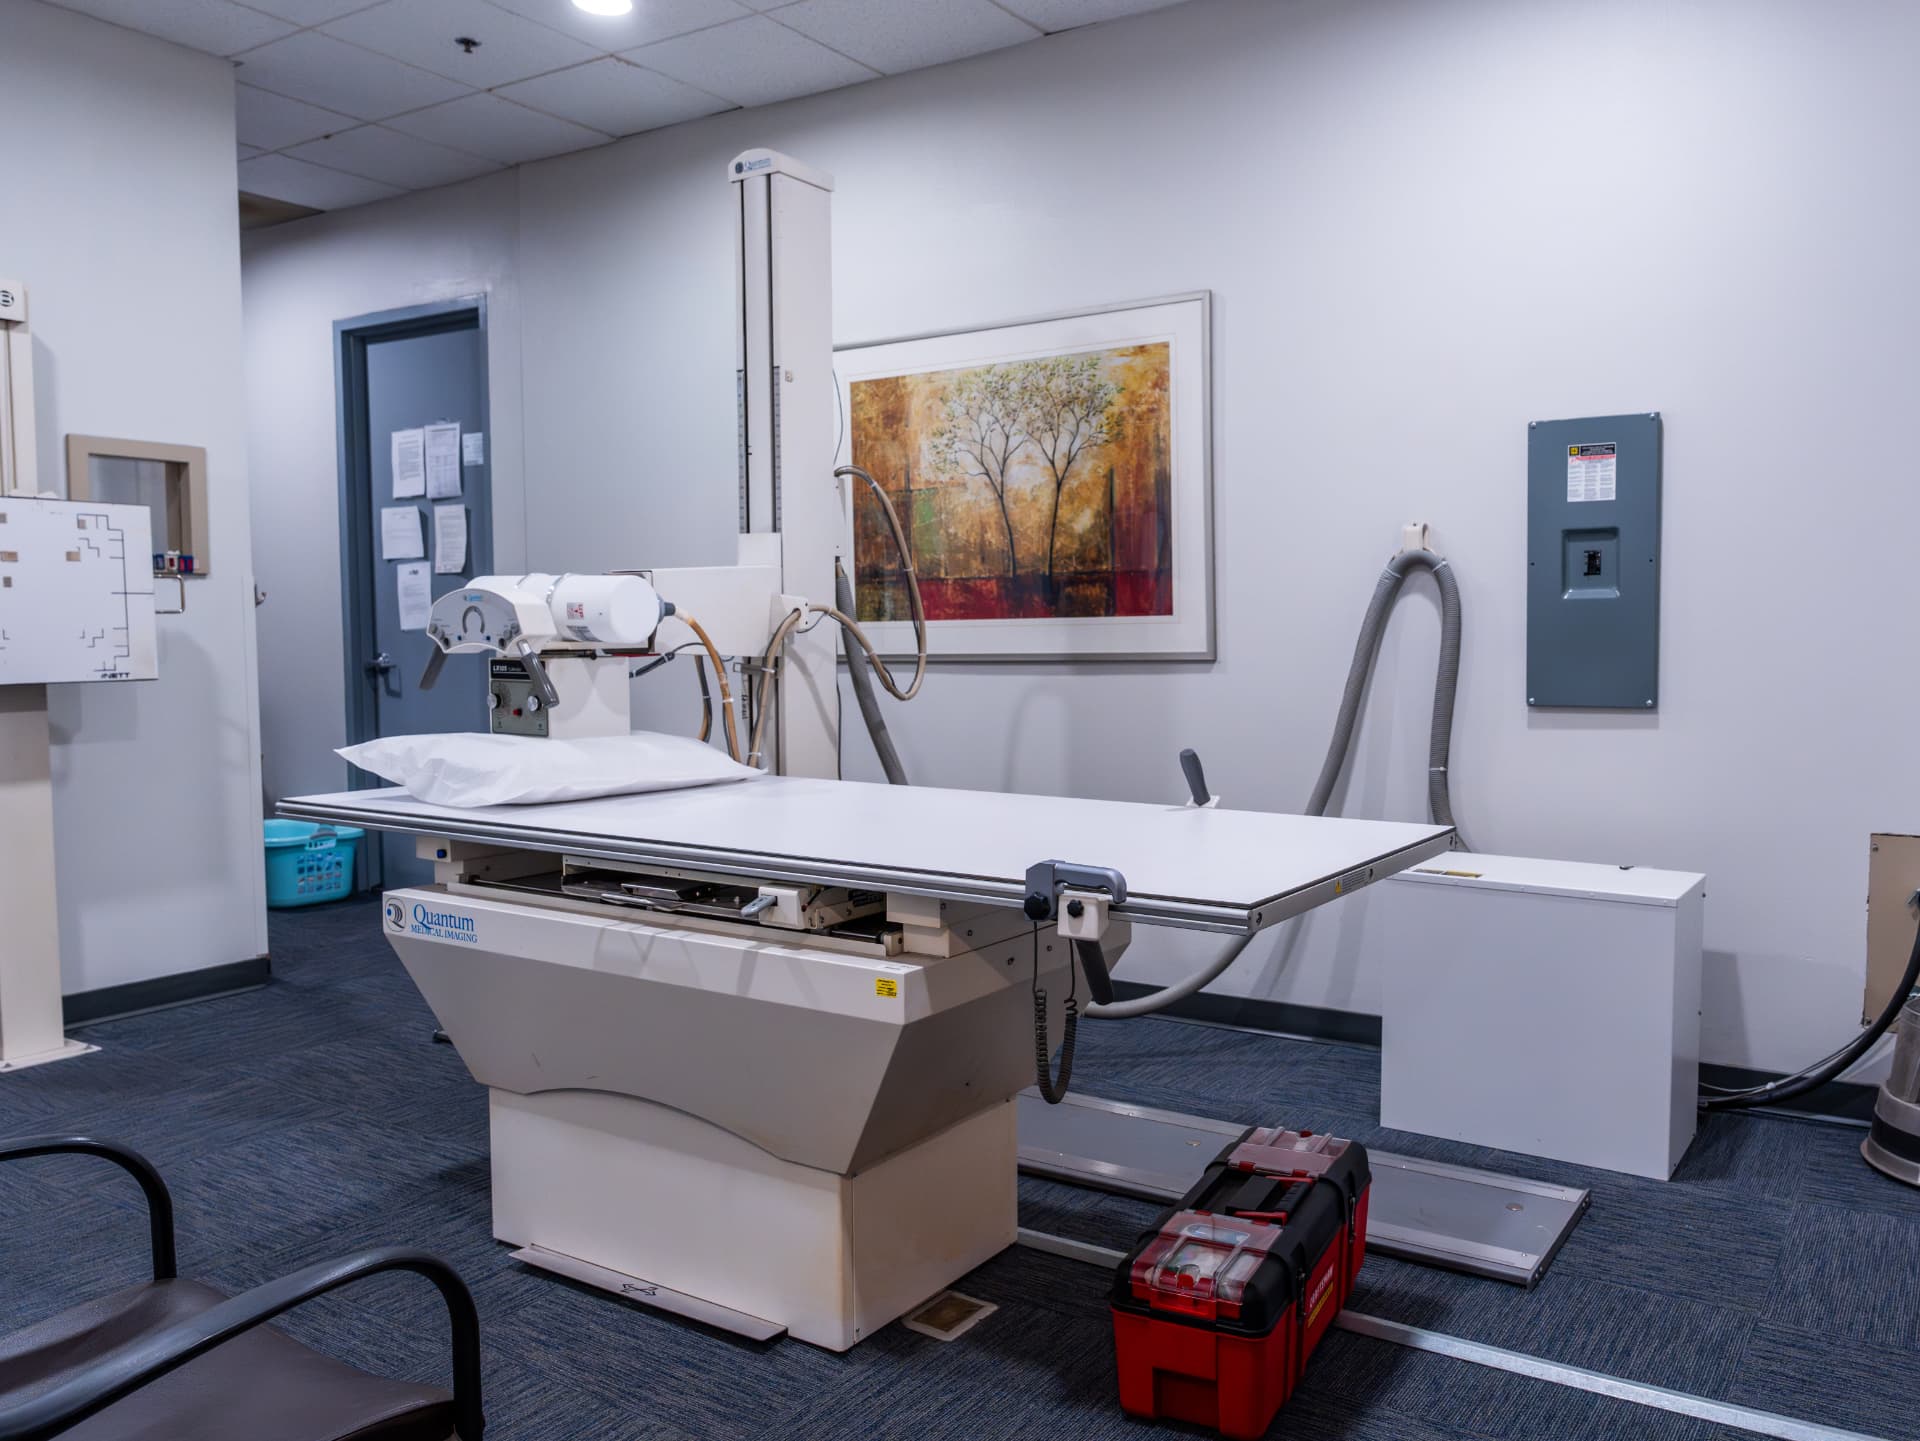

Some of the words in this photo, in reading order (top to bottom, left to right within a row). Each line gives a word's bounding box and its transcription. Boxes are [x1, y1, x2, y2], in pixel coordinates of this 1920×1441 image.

[413, 904, 474, 931] Quantum
[411, 923, 443, 938] MEDICAL
[444, 929, 478, 943] IMAGING
